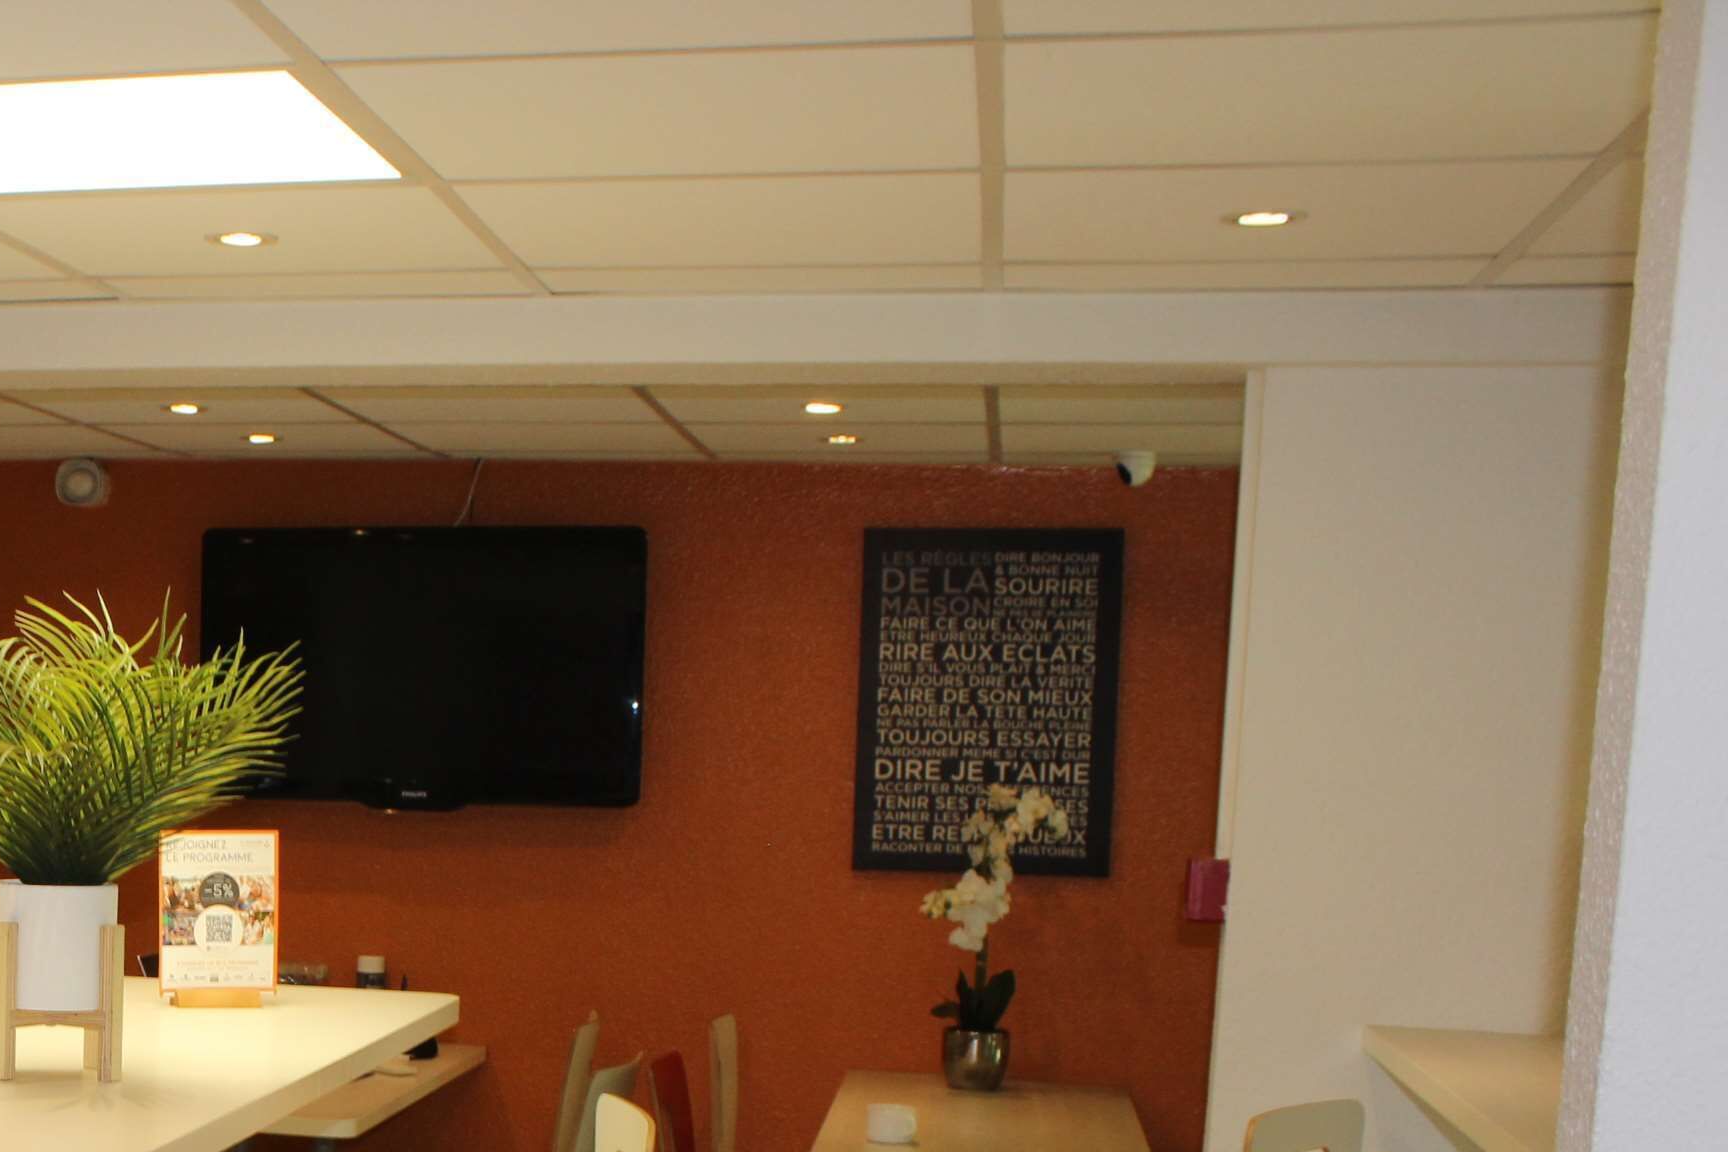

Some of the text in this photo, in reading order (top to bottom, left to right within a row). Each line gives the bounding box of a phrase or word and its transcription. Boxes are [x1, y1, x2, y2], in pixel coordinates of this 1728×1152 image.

[994, 551, 1100, 564] DIRE BONJOUR
[1008, 564, 1059, 576] BONNE
[1064, 565, 1098, 577] NUIT
[881, 567, 991, 594] DE LA
[993, 577, 1099, 596] SOURIRE
[880, 595, 992, 617] MAISON
[993, 596, 1098, 609] CROIRE EN SOI
[880, 616, 1096, 633] FAIRE CE QUE L'ON AIME
[920, 630, 987, 642] HEUREUX
[991, 631, 1052, 643] CHAQUE
[1057, 631, 1096, 643] JOUR
[879, 643, 1097, 663] RIRE AUX ECLATS
[879, 662, 912, 673] DIRE
[946, 663, 986, 674] VOUS
[1049, 663, 1097, 675] MERCI
[879, 674, 1095, 689] TOUJOURS DIRE LA VERITE
[877, 688, 1093, 705] FAIRE DE SON MIEUX
[877, 704, 1092, 721] GARDER LA TETE HAUTE
[922, 718, 970, 730] PARLER
[974, 720, 989, 730] LA
[993, 719, 1044, 731] BOUCHE
[878, 729, 1092, 748] TOUJOURS ESSAYER
[875, 746, 960, 758] PARDONNER
[1005, 748, 1017, 759] SI
[1062, 749, 1091, 761] DUR
[874, 758, 1091, 784] DIRE JE T'AIME
[875, 782, 951, 794] ACCEPTER
[874, 794, 929, 810] TENIR
[936, 795, 969, 811] SES
[874, 810, 930, 823] S'AIMER
[934, 811, 960, 823] LES
[872, 823, 926, 841] ETRE
[872, 840, 943, 853] RACONTER
[946, 842, 962, 854] DE
[1017, 844, 1088, 858] HISTOIRES
[183, 852, 254, 864] PROGRAMME
[204, 882, 234, 898] -5%
